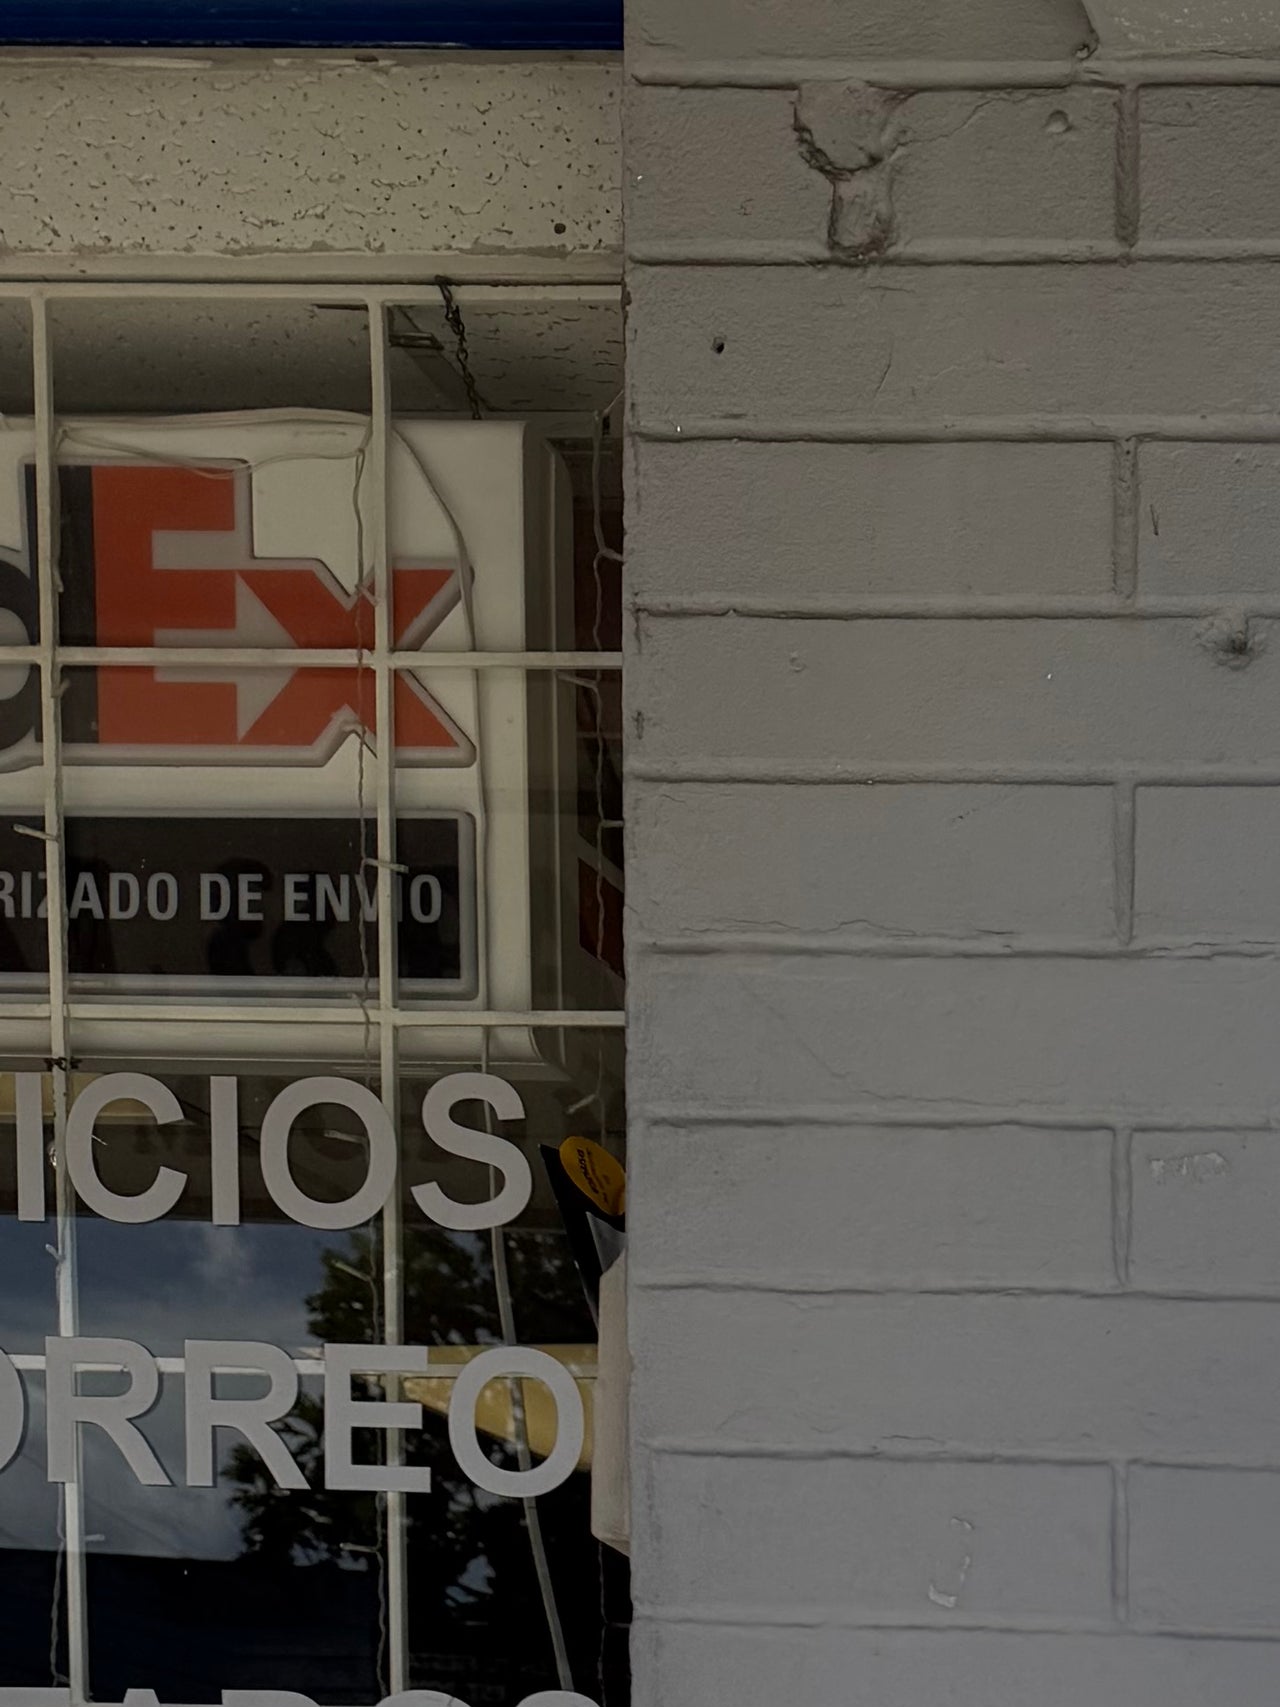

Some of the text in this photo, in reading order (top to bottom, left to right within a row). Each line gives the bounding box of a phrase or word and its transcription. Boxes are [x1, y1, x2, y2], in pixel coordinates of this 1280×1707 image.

[200, 873, 264, 921] DE
[284, 873, 442, 923] ENVO
[16, 1072, 532, 1231] ICIOS
[0, 1336, 584, 1498] RREO
